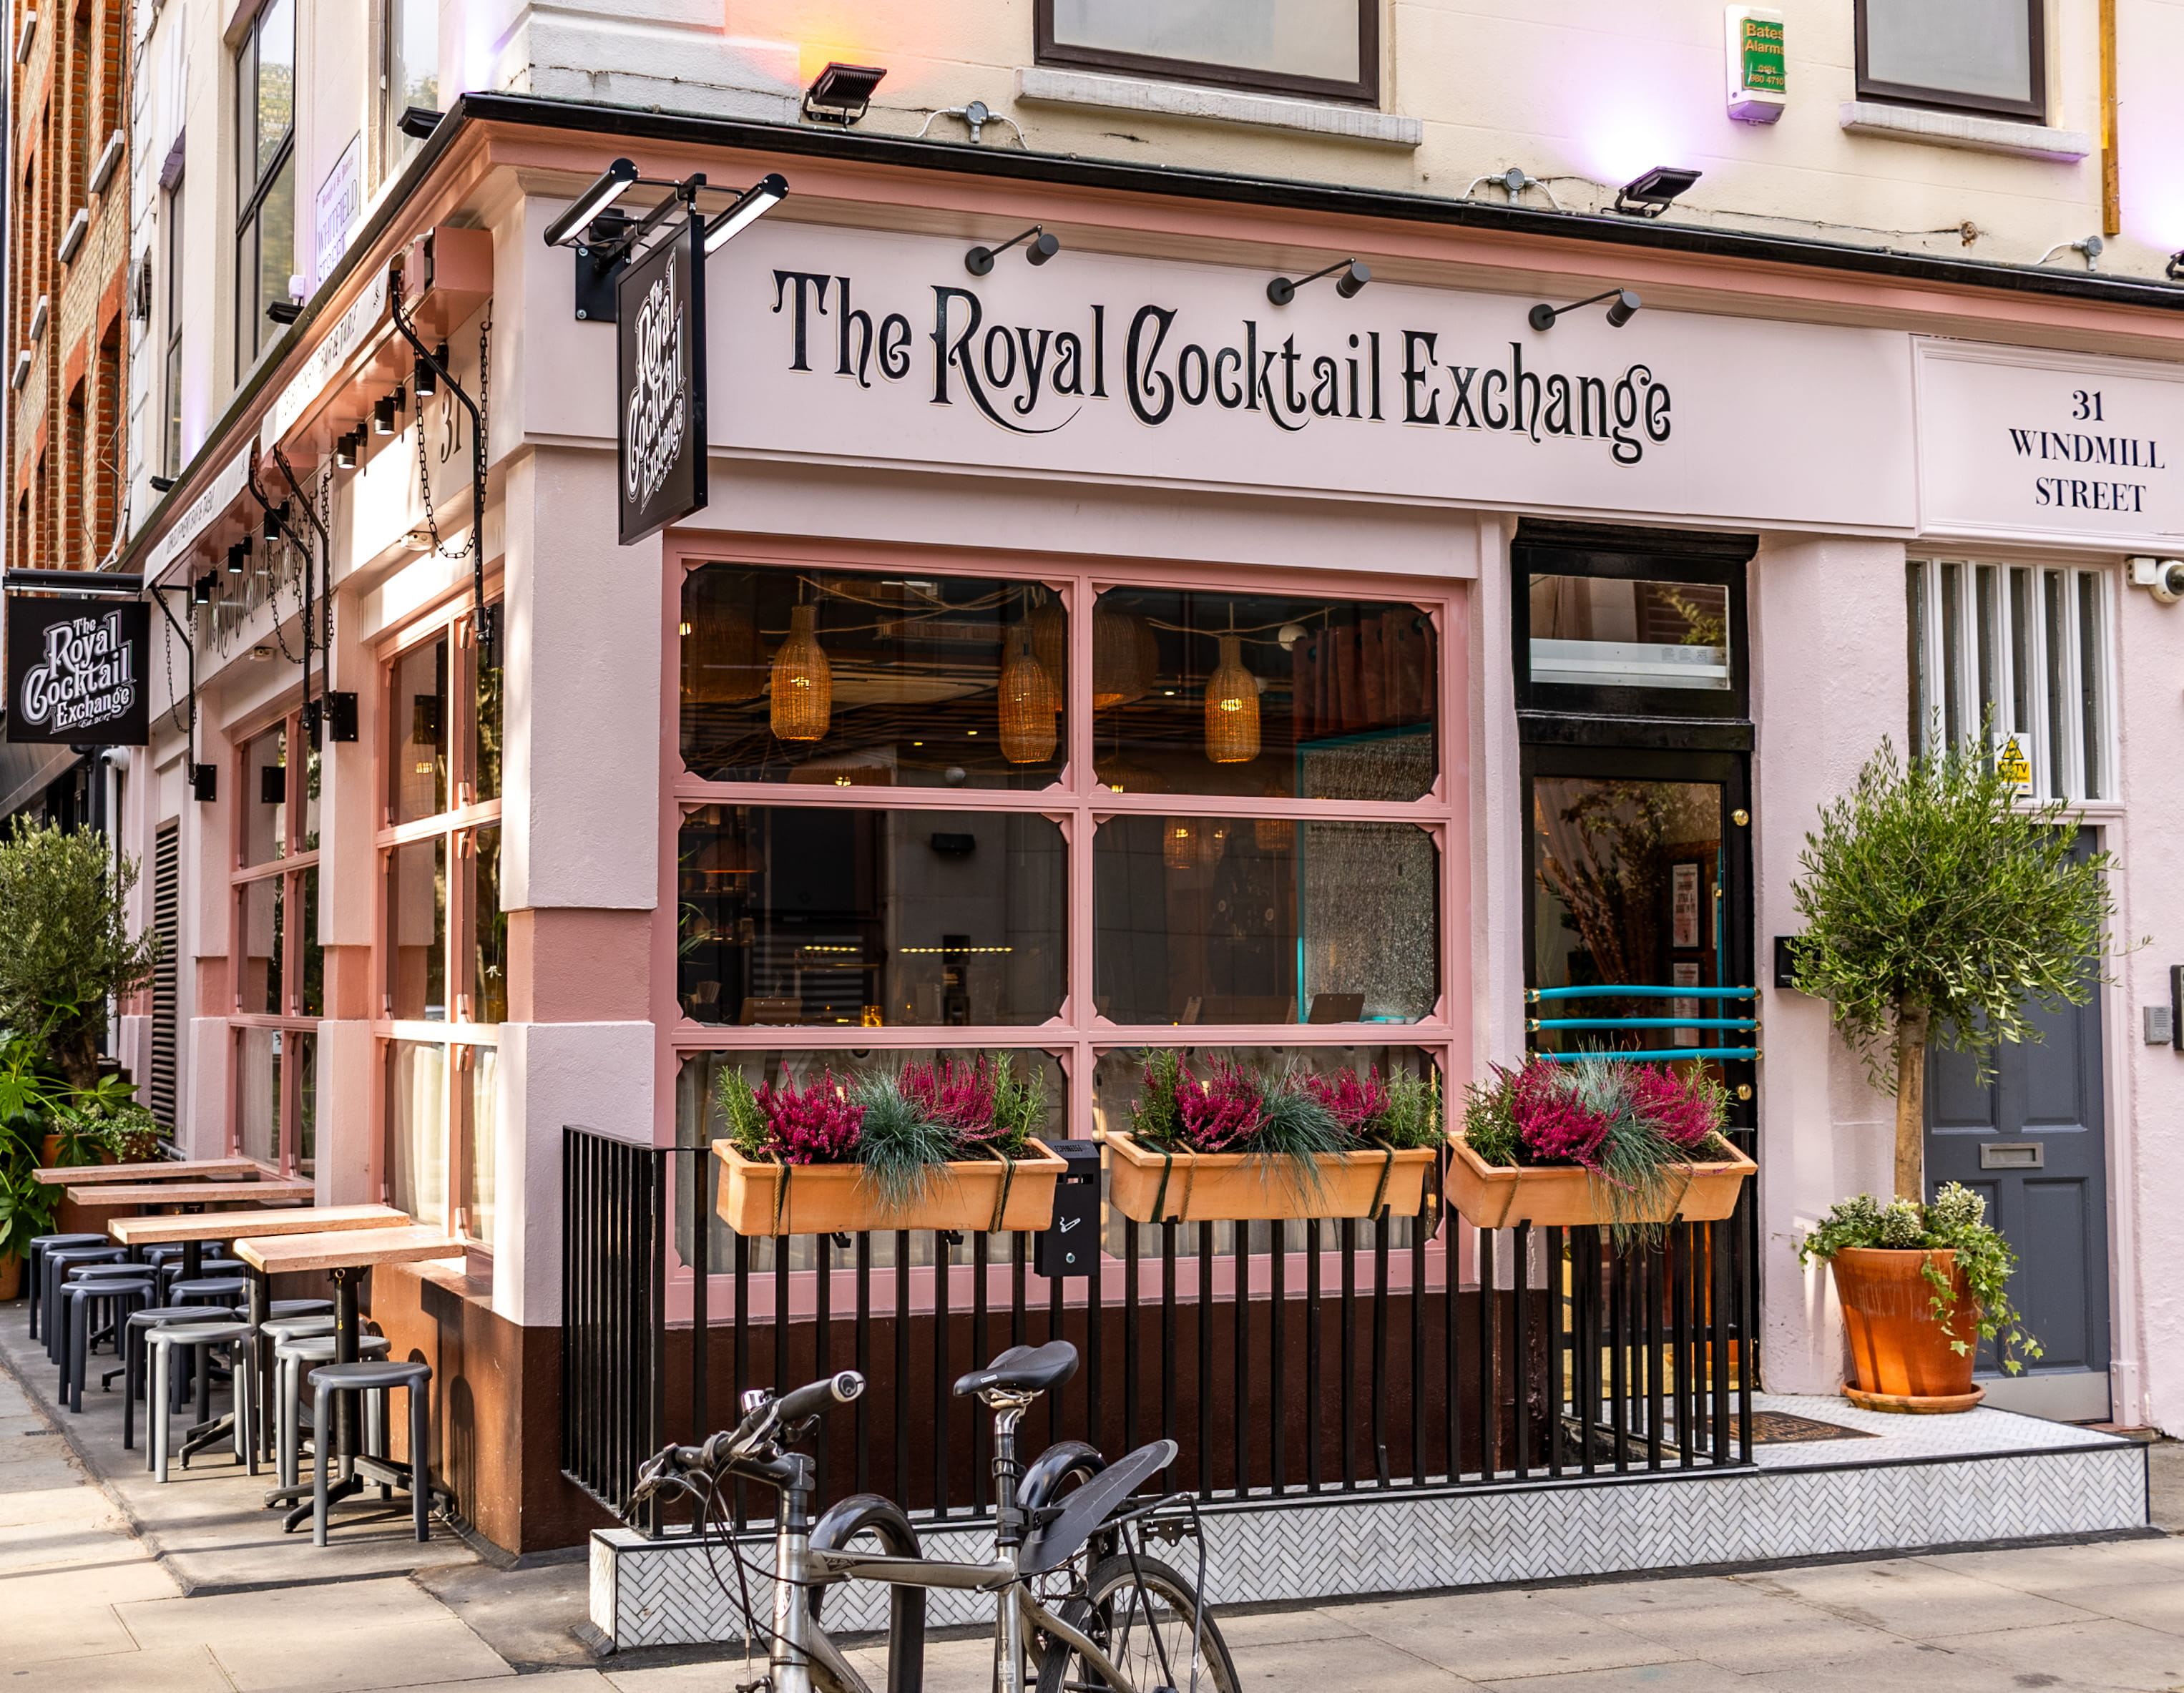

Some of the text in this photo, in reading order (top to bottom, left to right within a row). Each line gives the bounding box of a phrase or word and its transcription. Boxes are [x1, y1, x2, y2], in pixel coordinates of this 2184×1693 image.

[1745, 23, 1783, 40] Bates
[1745, 39, 1784, 55] Alarms
[638, 262, 675, 415] Royal
[771, 270, 1672, 465] The Royal Cocktail Exchange
[441, 374, 462, 464] 31
[628, 318, 681, 494] Cocktail
[2072, 390, 2106, 421] 31
[644, 398, 682, 499] Exchange
[2008, 428, 2166, 469] WINDMILL
[2035, 476, 2147, 513] STREET
[48, 615, 117, 679] Royal
[73, 617, 97, 636] The
[26, 647, 128, 721] Cocktail
[57, 687, 130, 727] Exchange
